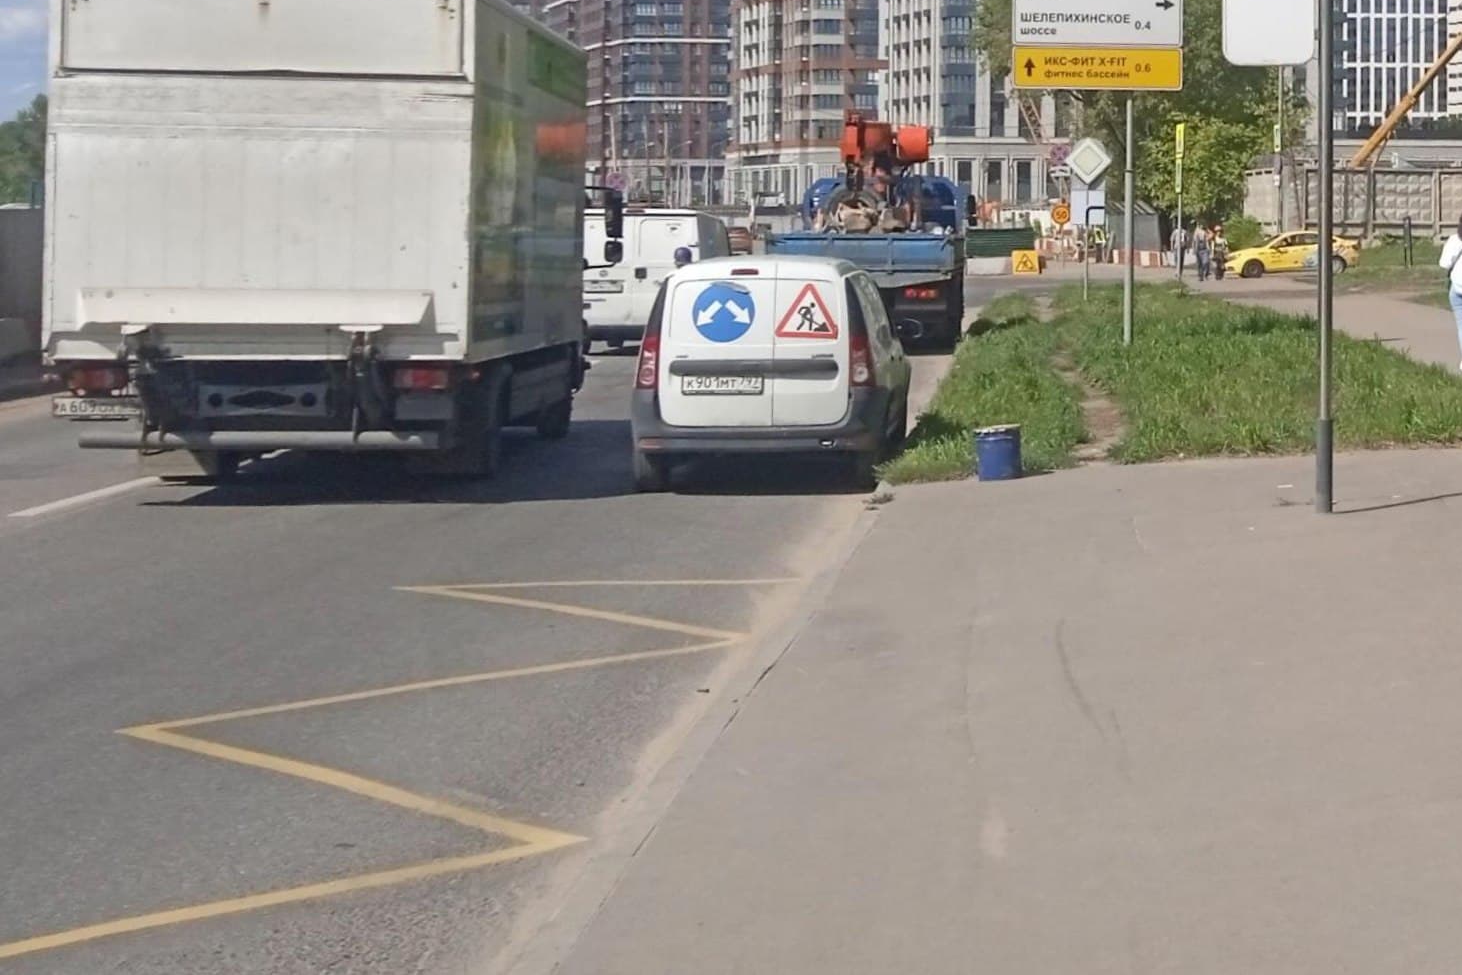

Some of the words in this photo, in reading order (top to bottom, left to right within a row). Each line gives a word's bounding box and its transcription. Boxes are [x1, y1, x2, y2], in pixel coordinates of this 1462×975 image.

[1020, 13, 1131, 24] ШЕЛЕПИХИНСКОЕ
[1134, 21, 1151, 30] 0.4
[1020, 27, 1057, 35] шоссе
[1044, 57, 1096, 66] ИКС-ФИТ
[1099, 57, 1127, 66] X-FIT
[1135, 63, 1151, 73] 0.6
[1044, 69, 1083, 79] фитнес
[1086, 68, 1130, 79] бассейн
